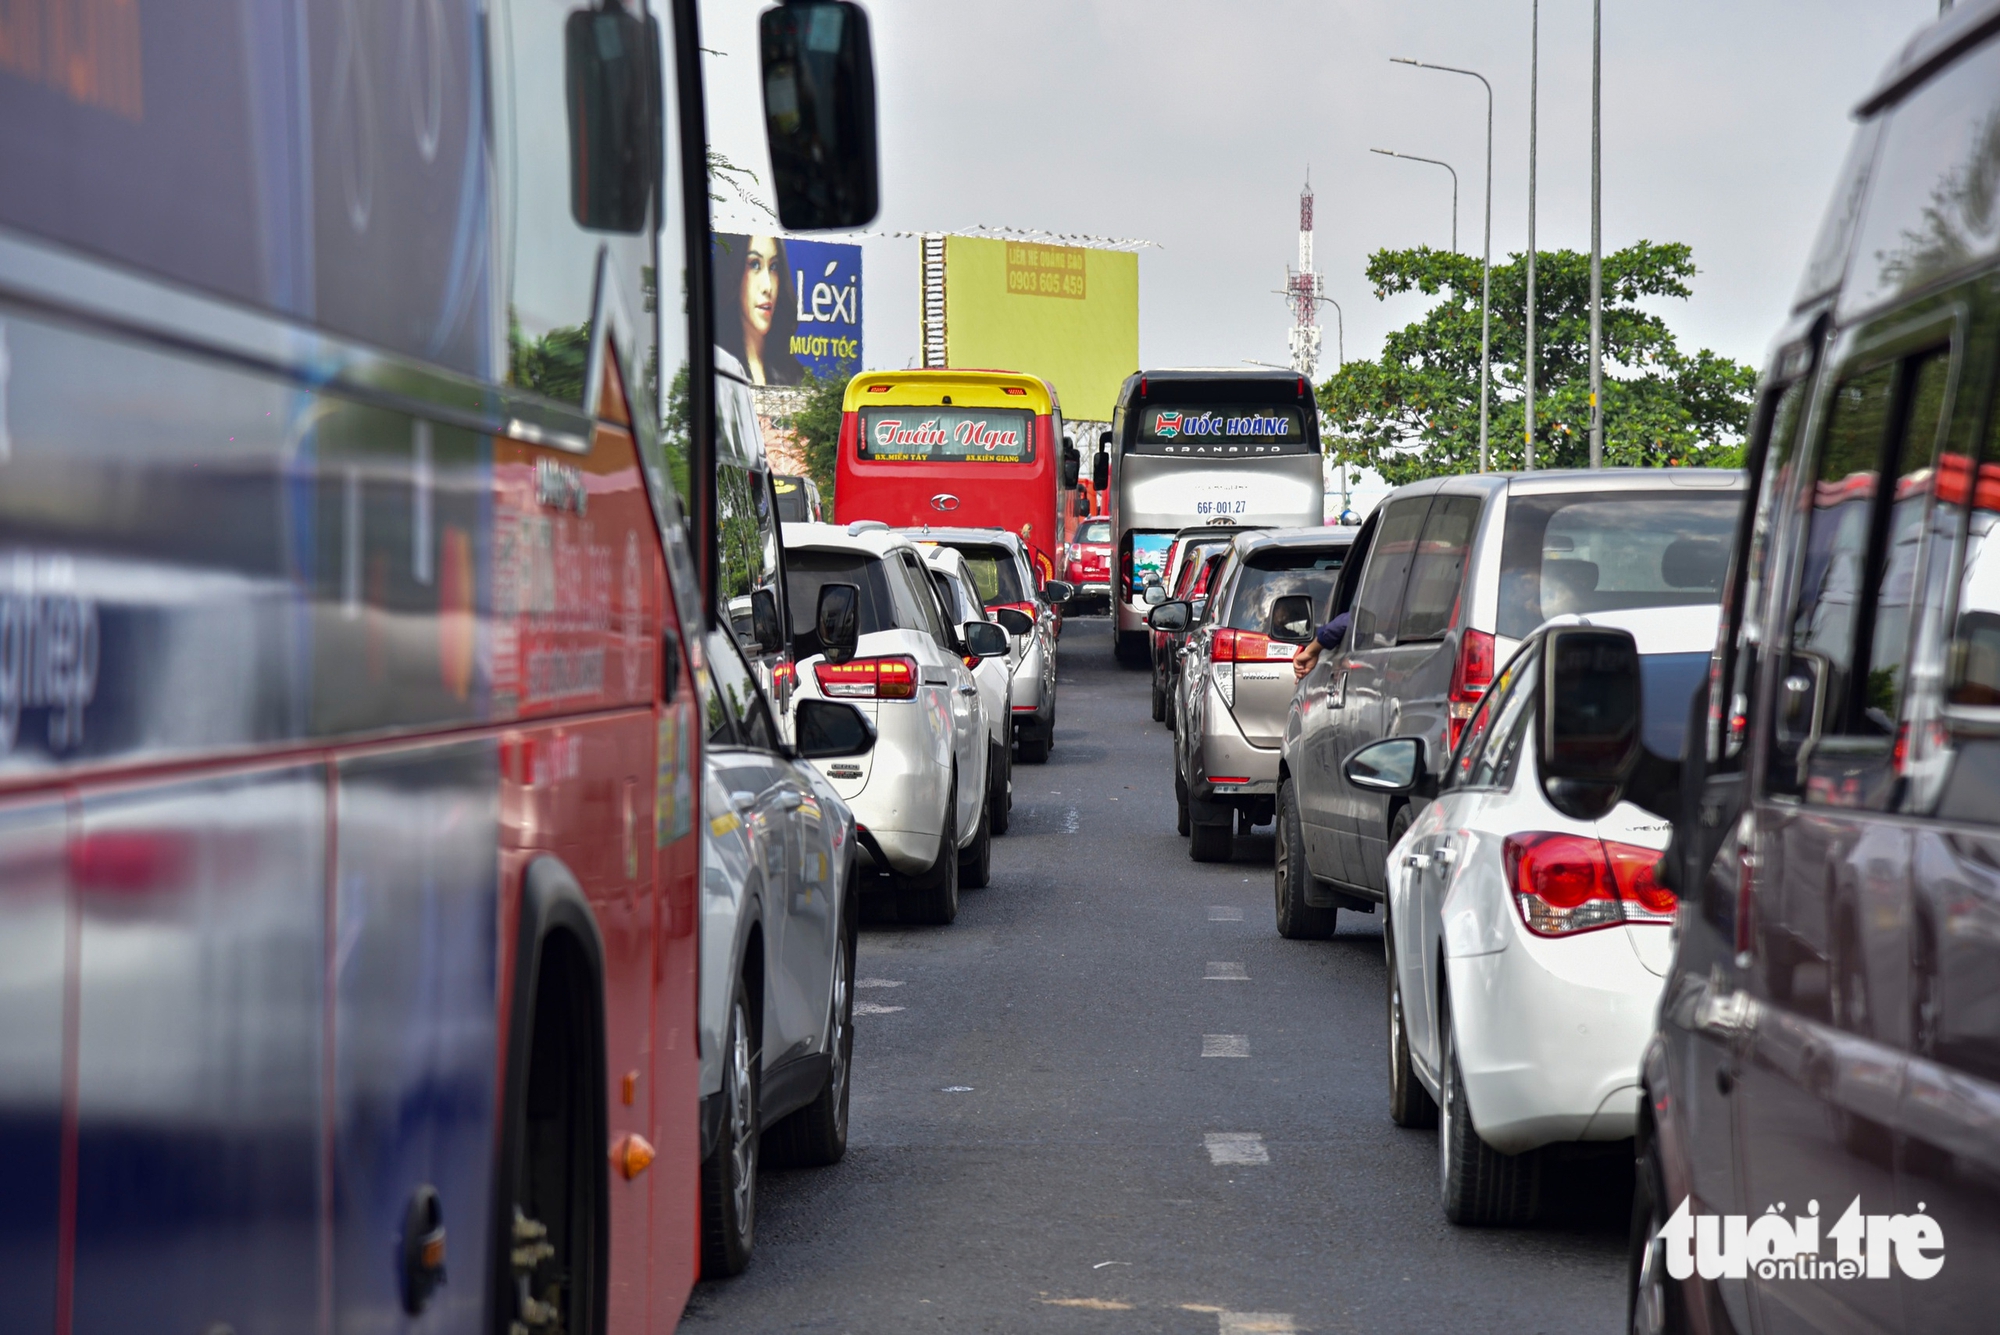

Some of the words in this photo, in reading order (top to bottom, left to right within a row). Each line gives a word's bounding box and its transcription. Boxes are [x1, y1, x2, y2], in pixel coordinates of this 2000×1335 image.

[797, 261, 857, 325] Léxi
[1009, 270, 1036, 291] 0903
[1039, 272, 1060, 293] 605
[1063, 274, 1084, 296] 459
[789, 335, 829, 362] MƯỢT
[830, 335, 858, 359] TÓC
[875, 419, 949, 446] Tuấn
[954, 420, 1019, 451] Nga
[1197, 500, 1246, 514] 66F-001.27
